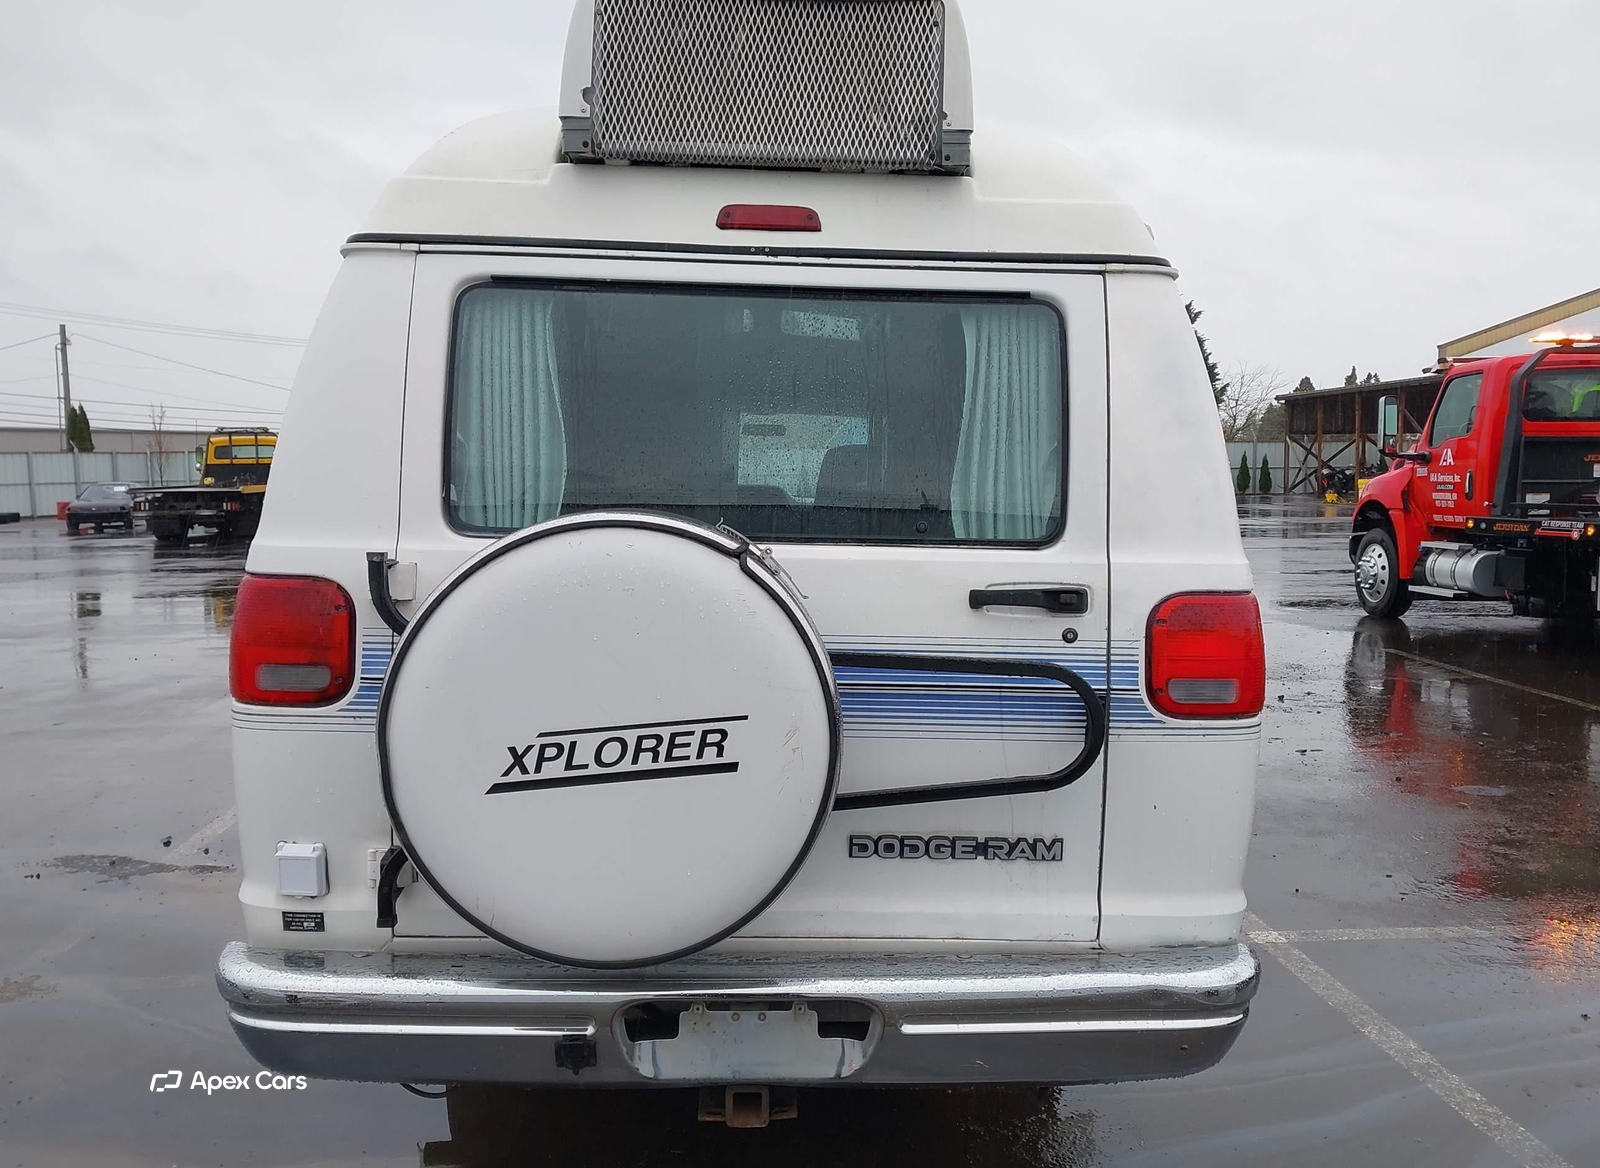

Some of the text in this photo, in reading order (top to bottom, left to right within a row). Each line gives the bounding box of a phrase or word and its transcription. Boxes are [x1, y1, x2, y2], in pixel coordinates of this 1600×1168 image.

[500, 728, 729, 778] XPLORER
[849, 834, 1064, 861] DODGE RAM
